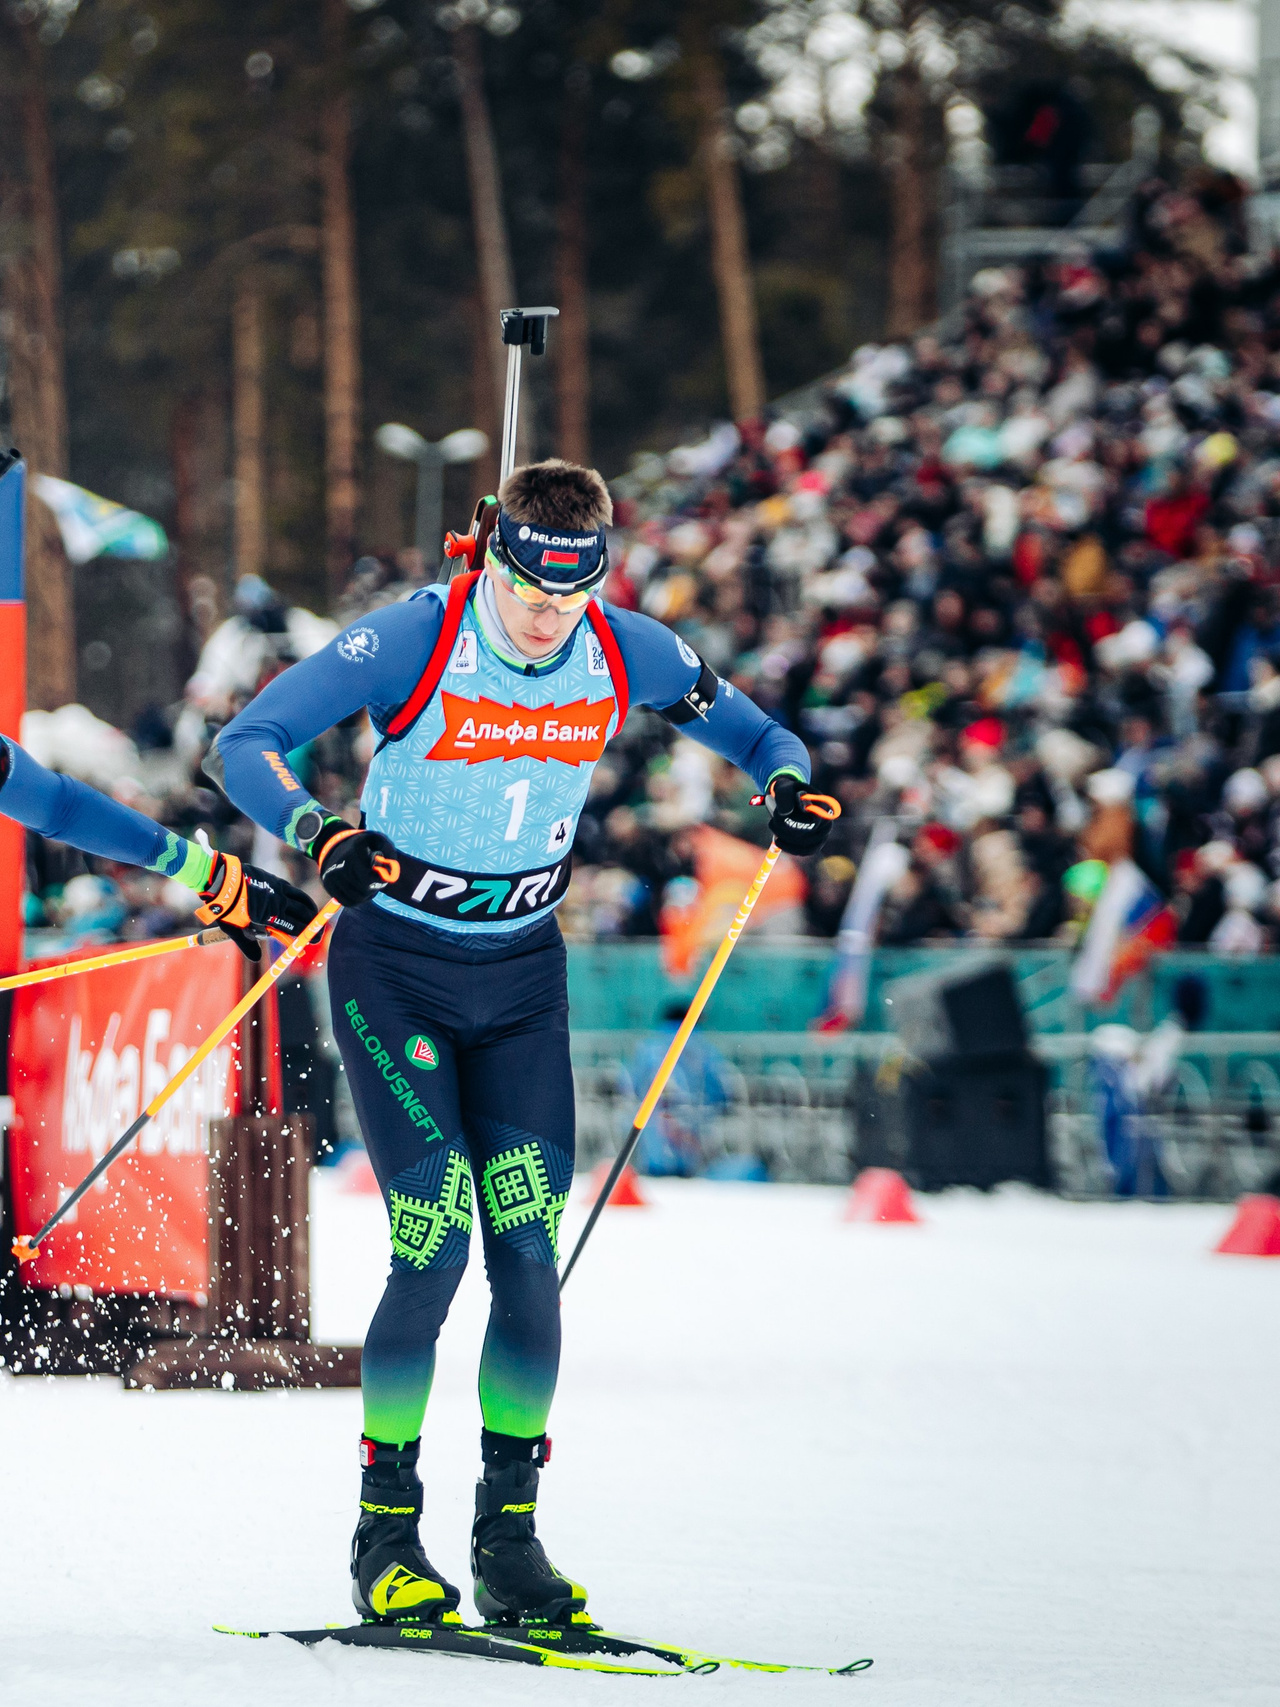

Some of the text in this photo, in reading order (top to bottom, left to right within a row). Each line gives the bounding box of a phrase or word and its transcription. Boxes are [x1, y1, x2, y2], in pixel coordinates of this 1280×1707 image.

[531, 531, 598, 548] BELORUSNEFT
[455, 717, 601, 747] Альфа Банк
[380, 786, 390, 817] 1
[504, 779, 531, 841] 1
[554, 822, 567, 844] 4
[411, 865, 562, 915] PARI
[344, 998, 444, 1143] BELORUSNEFT
[502, 1502, 536, 1514] FISC
[400, 1628, 433, 1639] FISCHER
[527, 1629, 562, 1640] FISCHER
